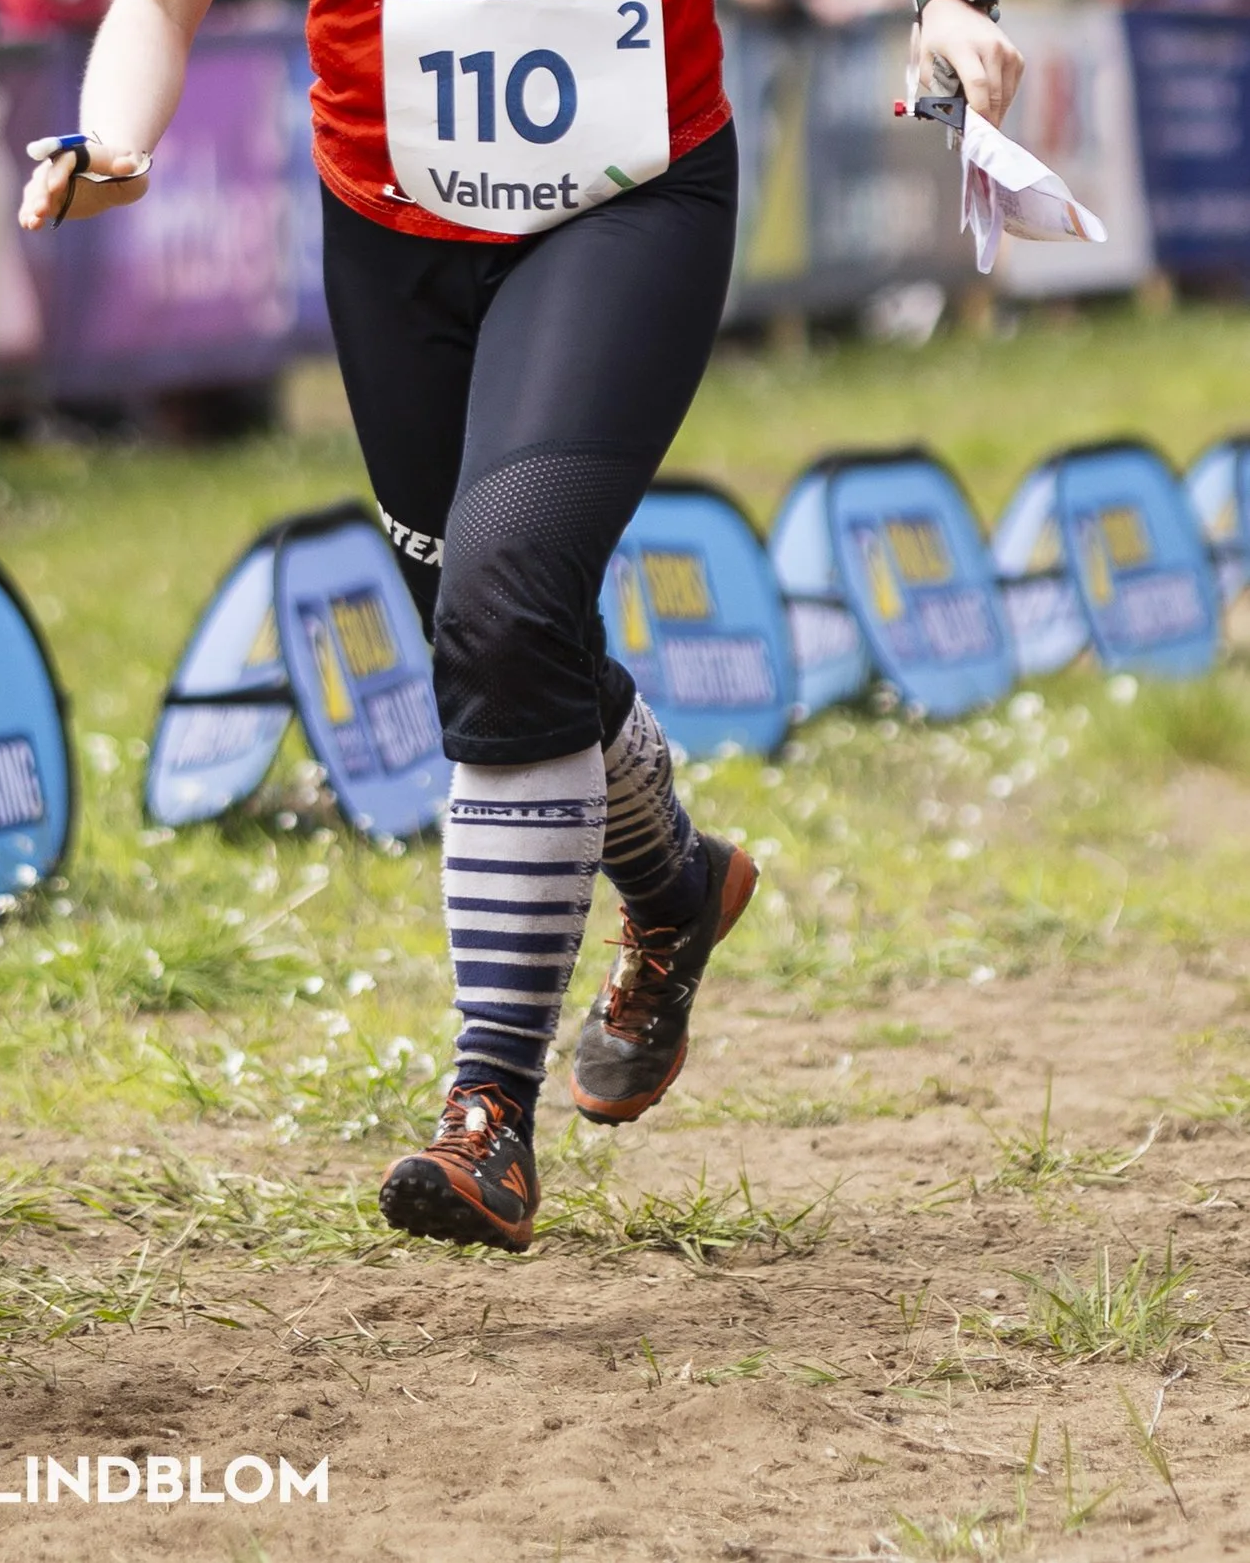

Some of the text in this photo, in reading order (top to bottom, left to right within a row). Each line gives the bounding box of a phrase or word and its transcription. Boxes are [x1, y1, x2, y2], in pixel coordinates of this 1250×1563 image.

[616, 1, 651, 49] 2
[418, 49, 578, 144] 110
[428, 168, 579, 210] Valmet
